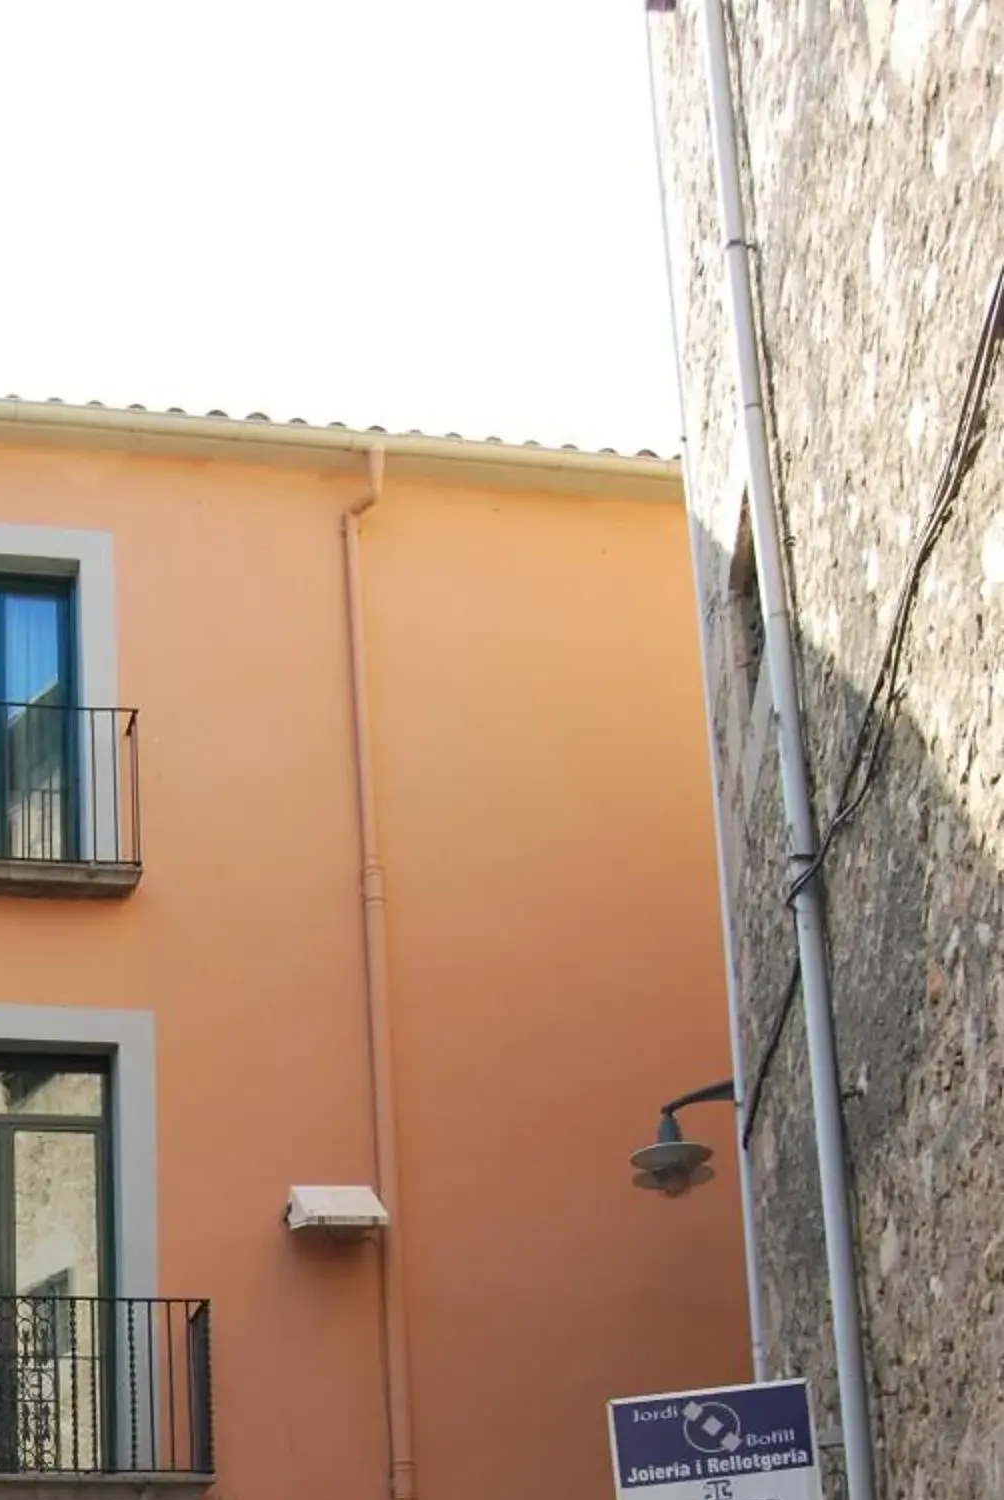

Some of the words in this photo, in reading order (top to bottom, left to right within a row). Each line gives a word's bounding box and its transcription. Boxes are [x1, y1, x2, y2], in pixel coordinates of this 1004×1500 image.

[633, 1405, 679, 1423] Jordi
[746, 1428, 795, 1446] Bofill
[627, 1461, 691, 1484] Joieria
[695, 1460, 701, 1475] i
[707, 1449, 809, 1474] Rellotgeria
